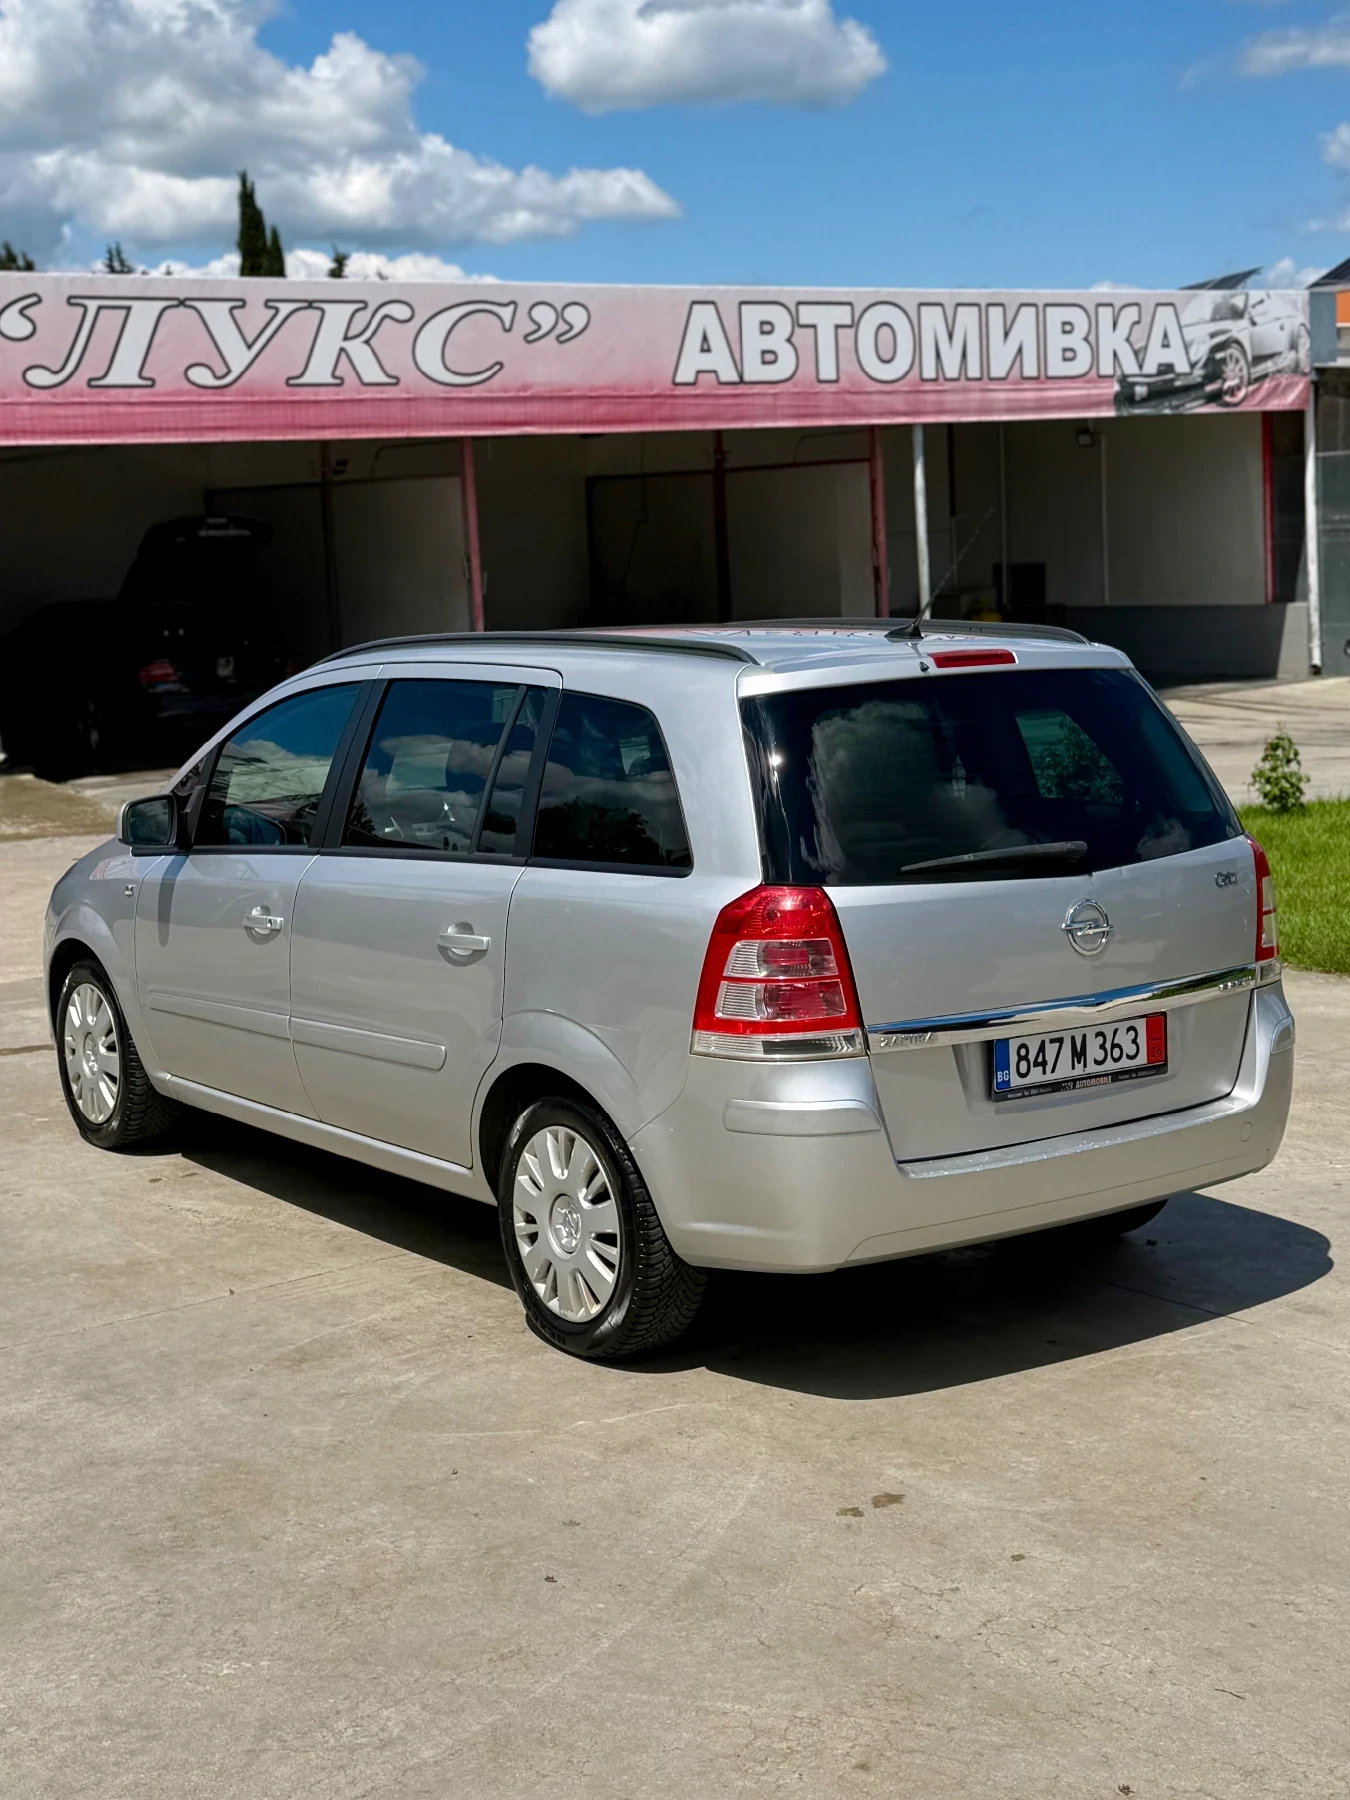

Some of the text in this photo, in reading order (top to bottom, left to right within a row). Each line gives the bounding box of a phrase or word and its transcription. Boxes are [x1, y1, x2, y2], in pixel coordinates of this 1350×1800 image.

[672, 300, 1195, 386] АВТОМИВКА
[1015, 1036, 1064, 1079] 847
[1093, 1025, 1140, 1066] 363
[997, 1069, 1010, 1083] BG
[1075, 1075, 1112, 1090] AUTOMOBILE
